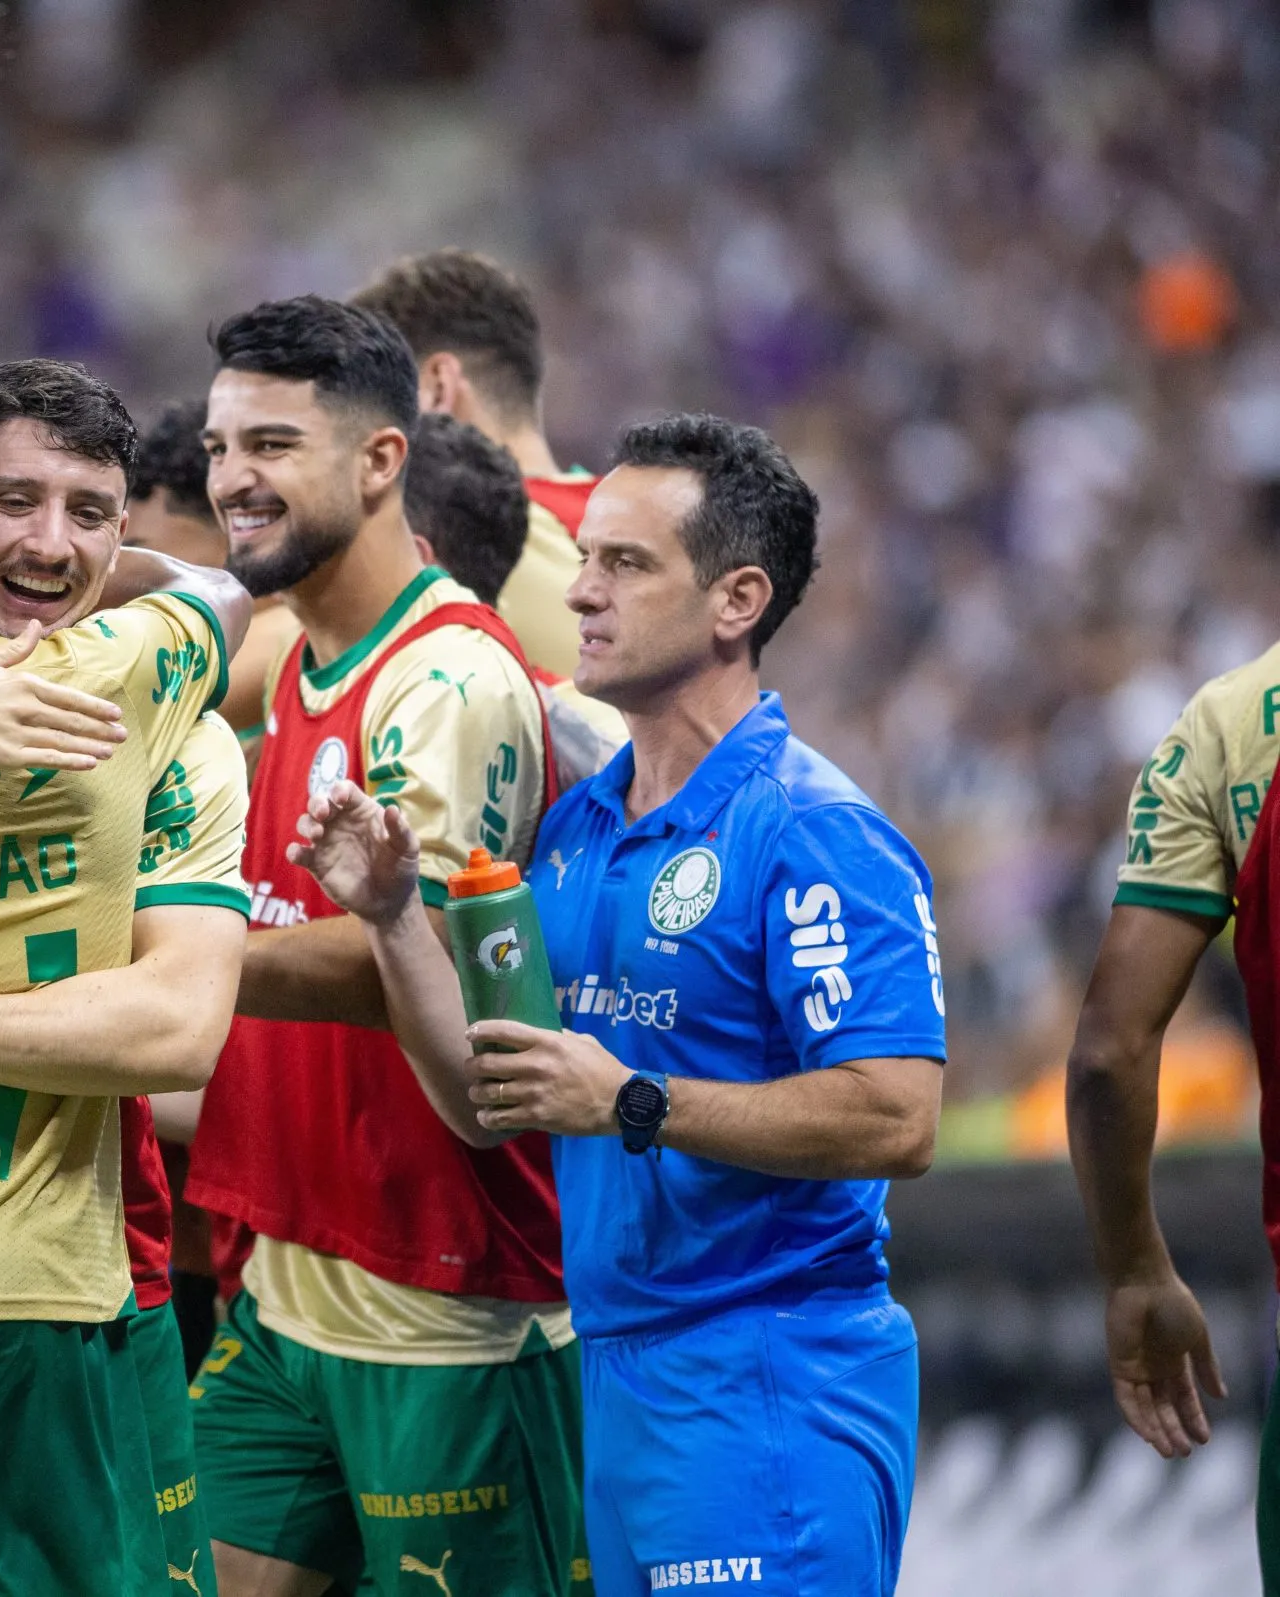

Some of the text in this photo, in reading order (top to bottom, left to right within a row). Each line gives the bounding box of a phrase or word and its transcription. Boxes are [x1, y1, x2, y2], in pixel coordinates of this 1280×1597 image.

[652, 880, 713, 929] PALMEIRAS
[477, 927, 523, 979] G
[360, 1484, 508, 1518] UNIASSELVI
